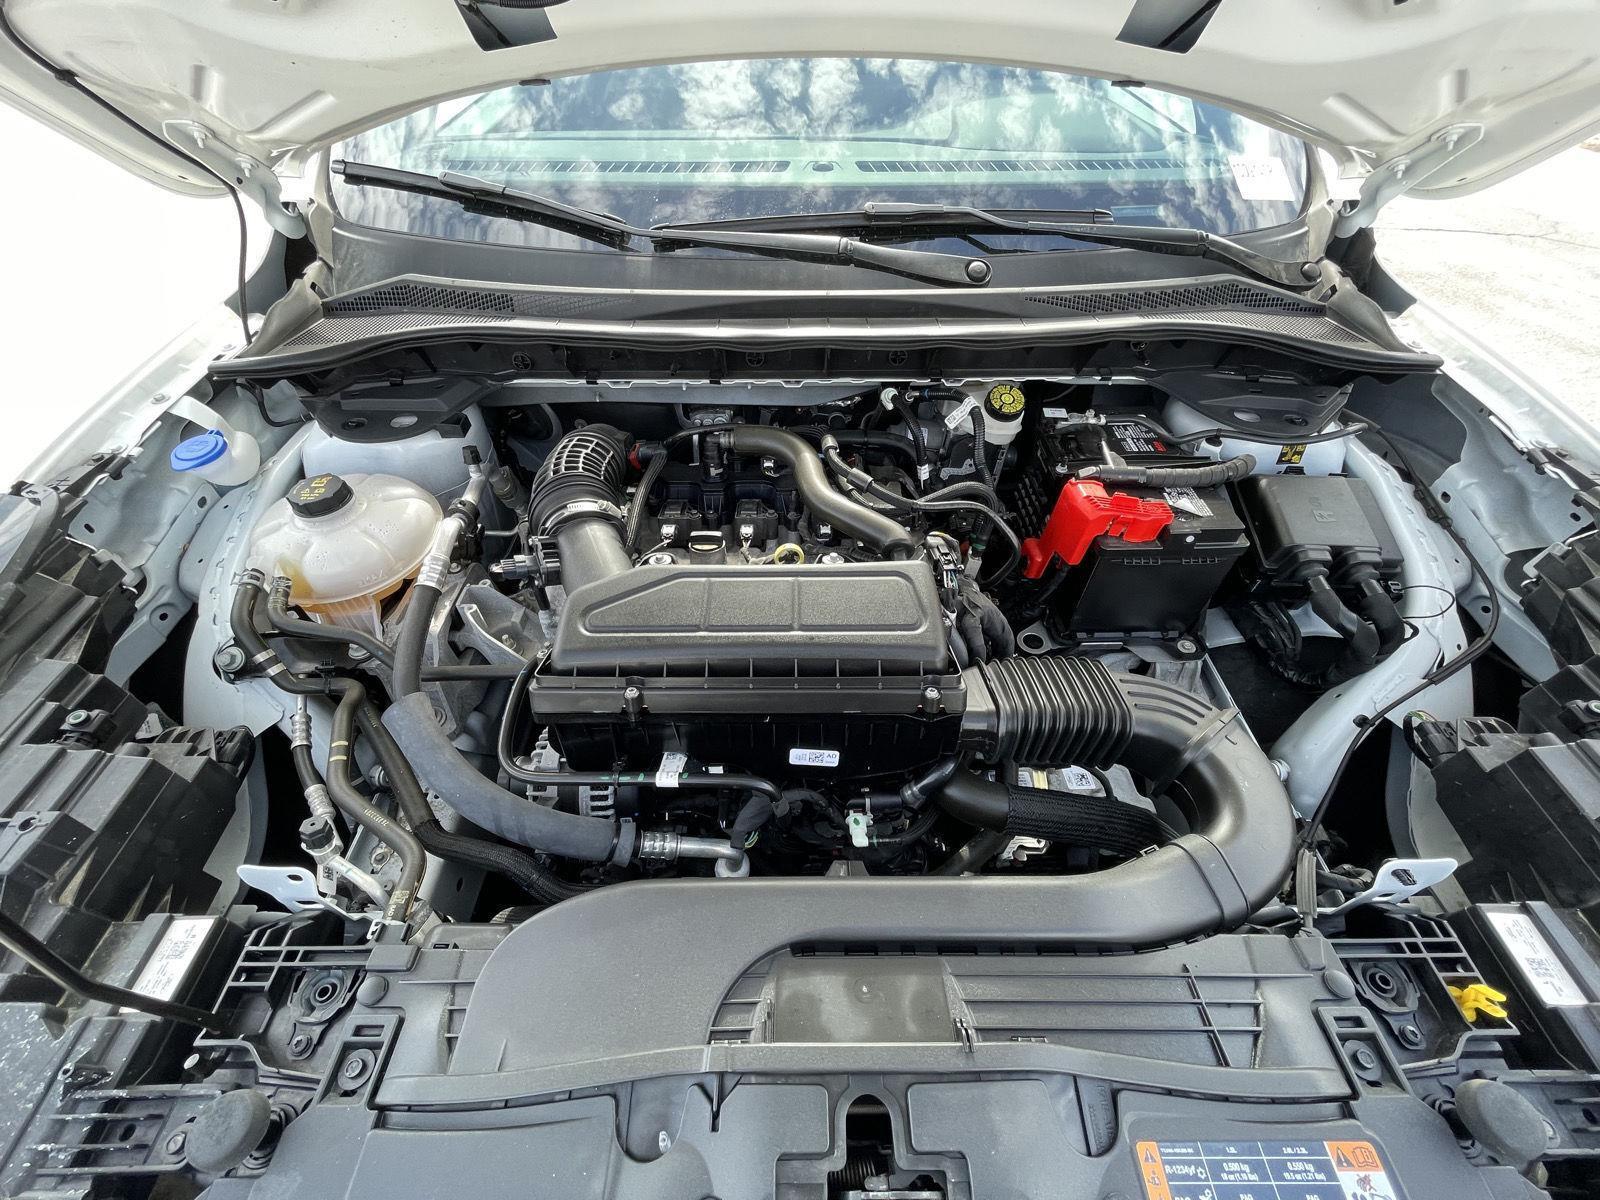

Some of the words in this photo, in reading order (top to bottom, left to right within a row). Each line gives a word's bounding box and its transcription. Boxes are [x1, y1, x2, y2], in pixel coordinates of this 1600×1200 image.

[1164, 1165, 1196, 1177] R-1234yf
[1222, 1162, 1240, 1171] 0.500
[1239, 1162, 1250, 1173] kg
[1303, 1161, 1315, 1172] kg
